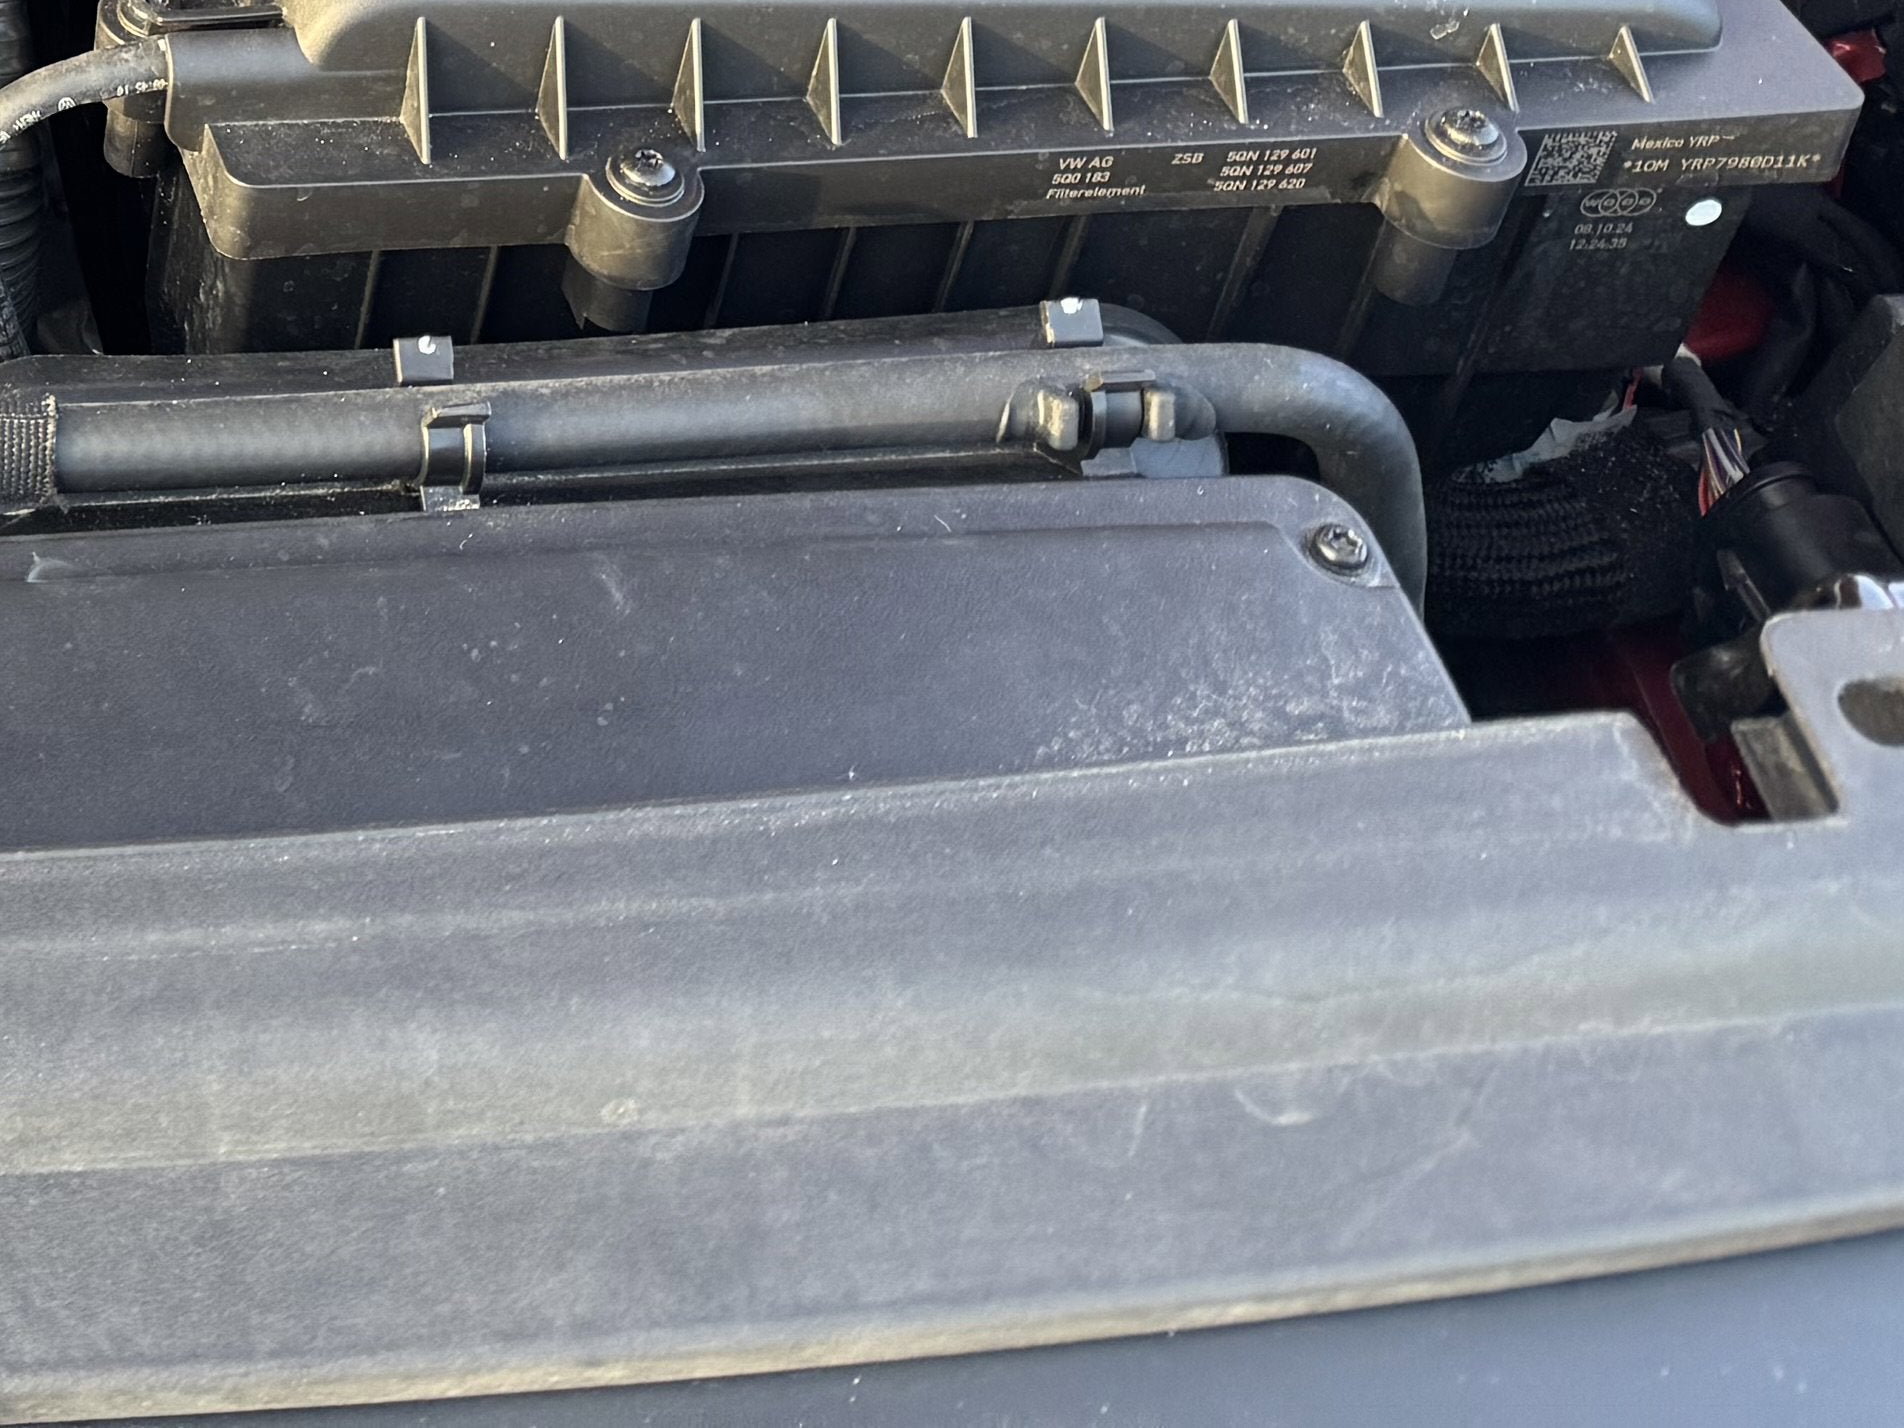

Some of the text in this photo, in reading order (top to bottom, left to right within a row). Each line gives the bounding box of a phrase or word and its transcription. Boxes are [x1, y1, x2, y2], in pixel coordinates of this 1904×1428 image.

[1631, 135, 1721, 150] Mexico YRP
[1059, 156, 1114, 170] VW AG
[1171, 153, 1204, 165] ZSB
[1262, 149, 1288, 161] 129
[1291, 148, 1317, 159] 601
[1256, 164, 1281, 176] 129
[1285, 163, 1312, 175] 607
[1084, 171, 1110, 184] 183
[1250, 179, 1275, 191] 129
[1278, 178, 1306, 190] 620
[1046, 184, 1146, 200] Filterelement
